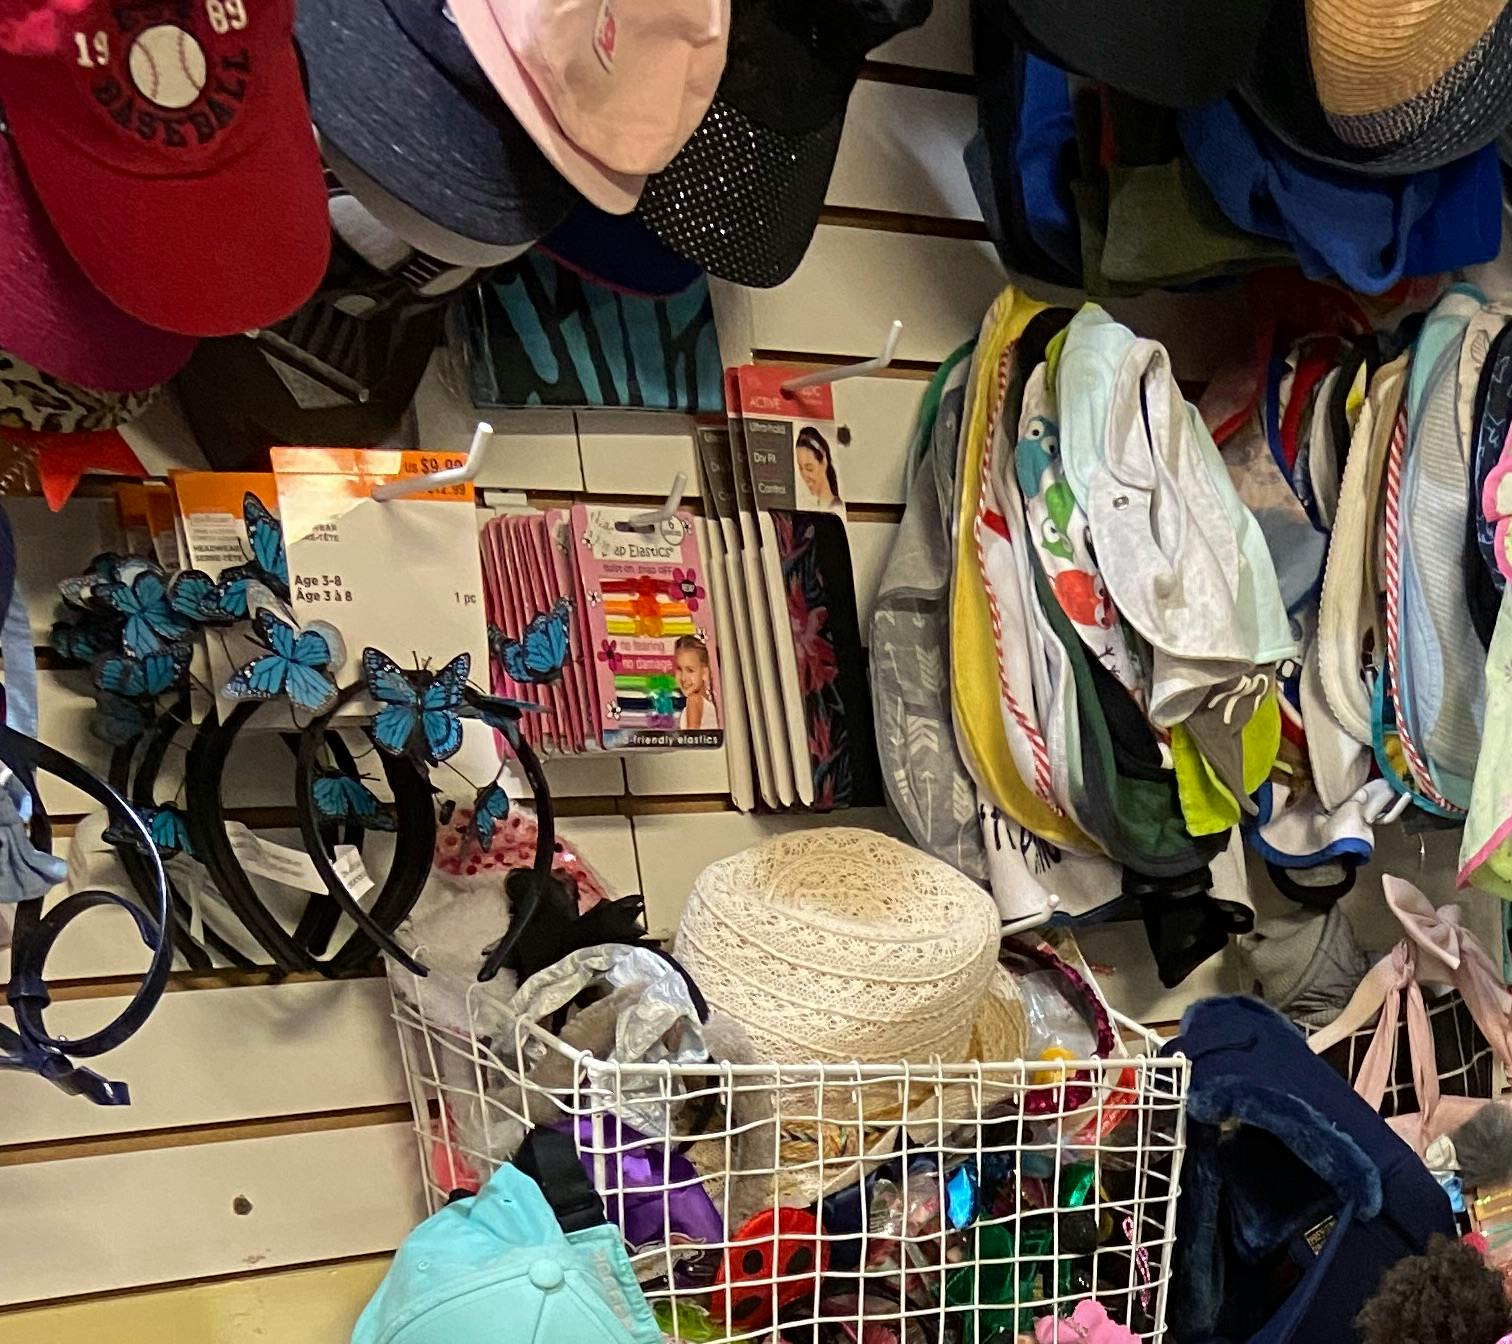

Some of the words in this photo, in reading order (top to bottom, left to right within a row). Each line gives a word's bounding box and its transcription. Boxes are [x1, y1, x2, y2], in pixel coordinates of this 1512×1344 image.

[205, 0, 248, 34] 89
[74, 31, 110, 68] 19
[93, 48, 251, 147] BASEBALL
[750, 397, 781, 409] ACTIVE
[753, 452, 767, 464] Dry
[294, 574, 319, 588] Age
[322, 574, 342, 587] 3-8
[323, 590, 331, 602] 3
[345, 590, 353, 602] 8
[454, 591, 460, 604] 1
[464, 593, 477, 608] pc
[677, 734, 718, 745] elastics
